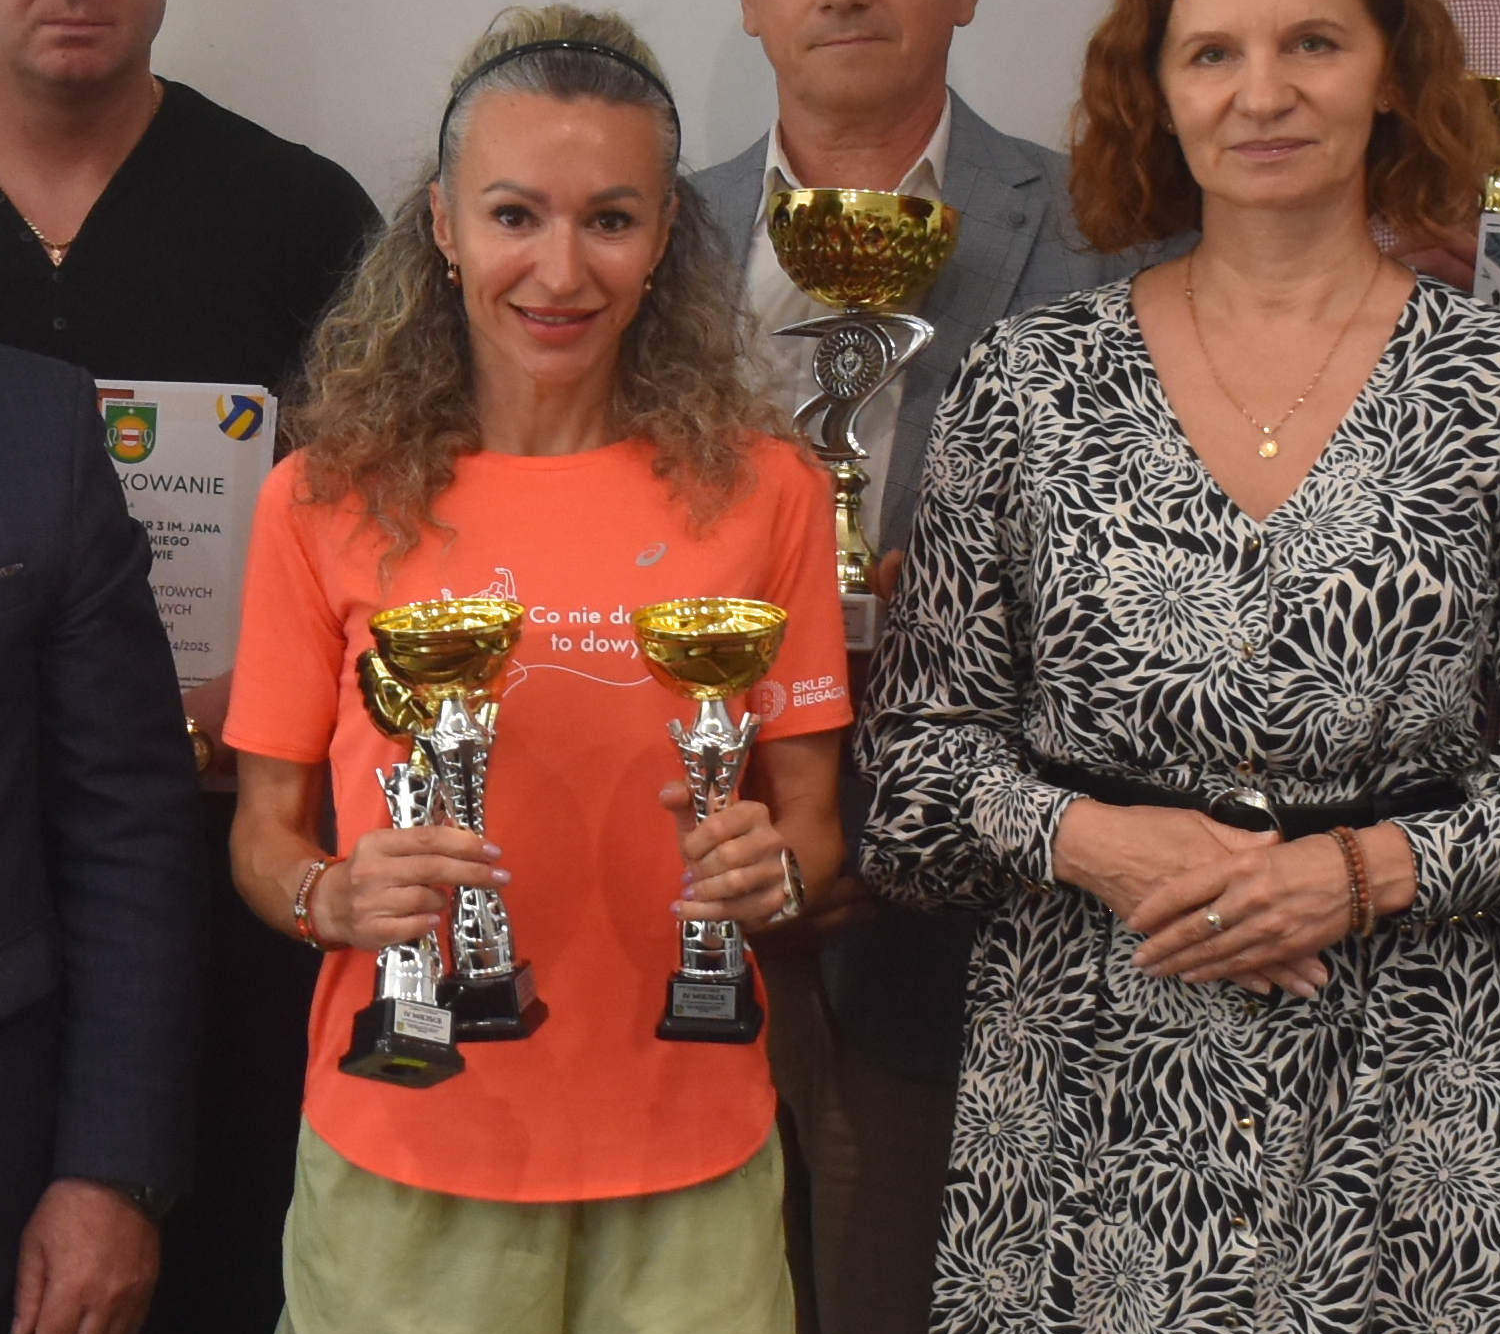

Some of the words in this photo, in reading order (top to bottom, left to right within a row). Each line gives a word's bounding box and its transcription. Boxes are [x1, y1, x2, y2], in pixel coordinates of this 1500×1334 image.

[119, 473, 224, 495] KOWANIE
[157, 521, 164, 530] 3
[167, 522, 185, 532] IM.
[188, 523, 221, 534] JANA
[149, 535, 189, 546] KIEGO
[529, 606, 560, 624] Co
[568, 607, 602, 624] nie
[551, 633, 572, 652] to
[792, 675, 833, 694] SKLEP
